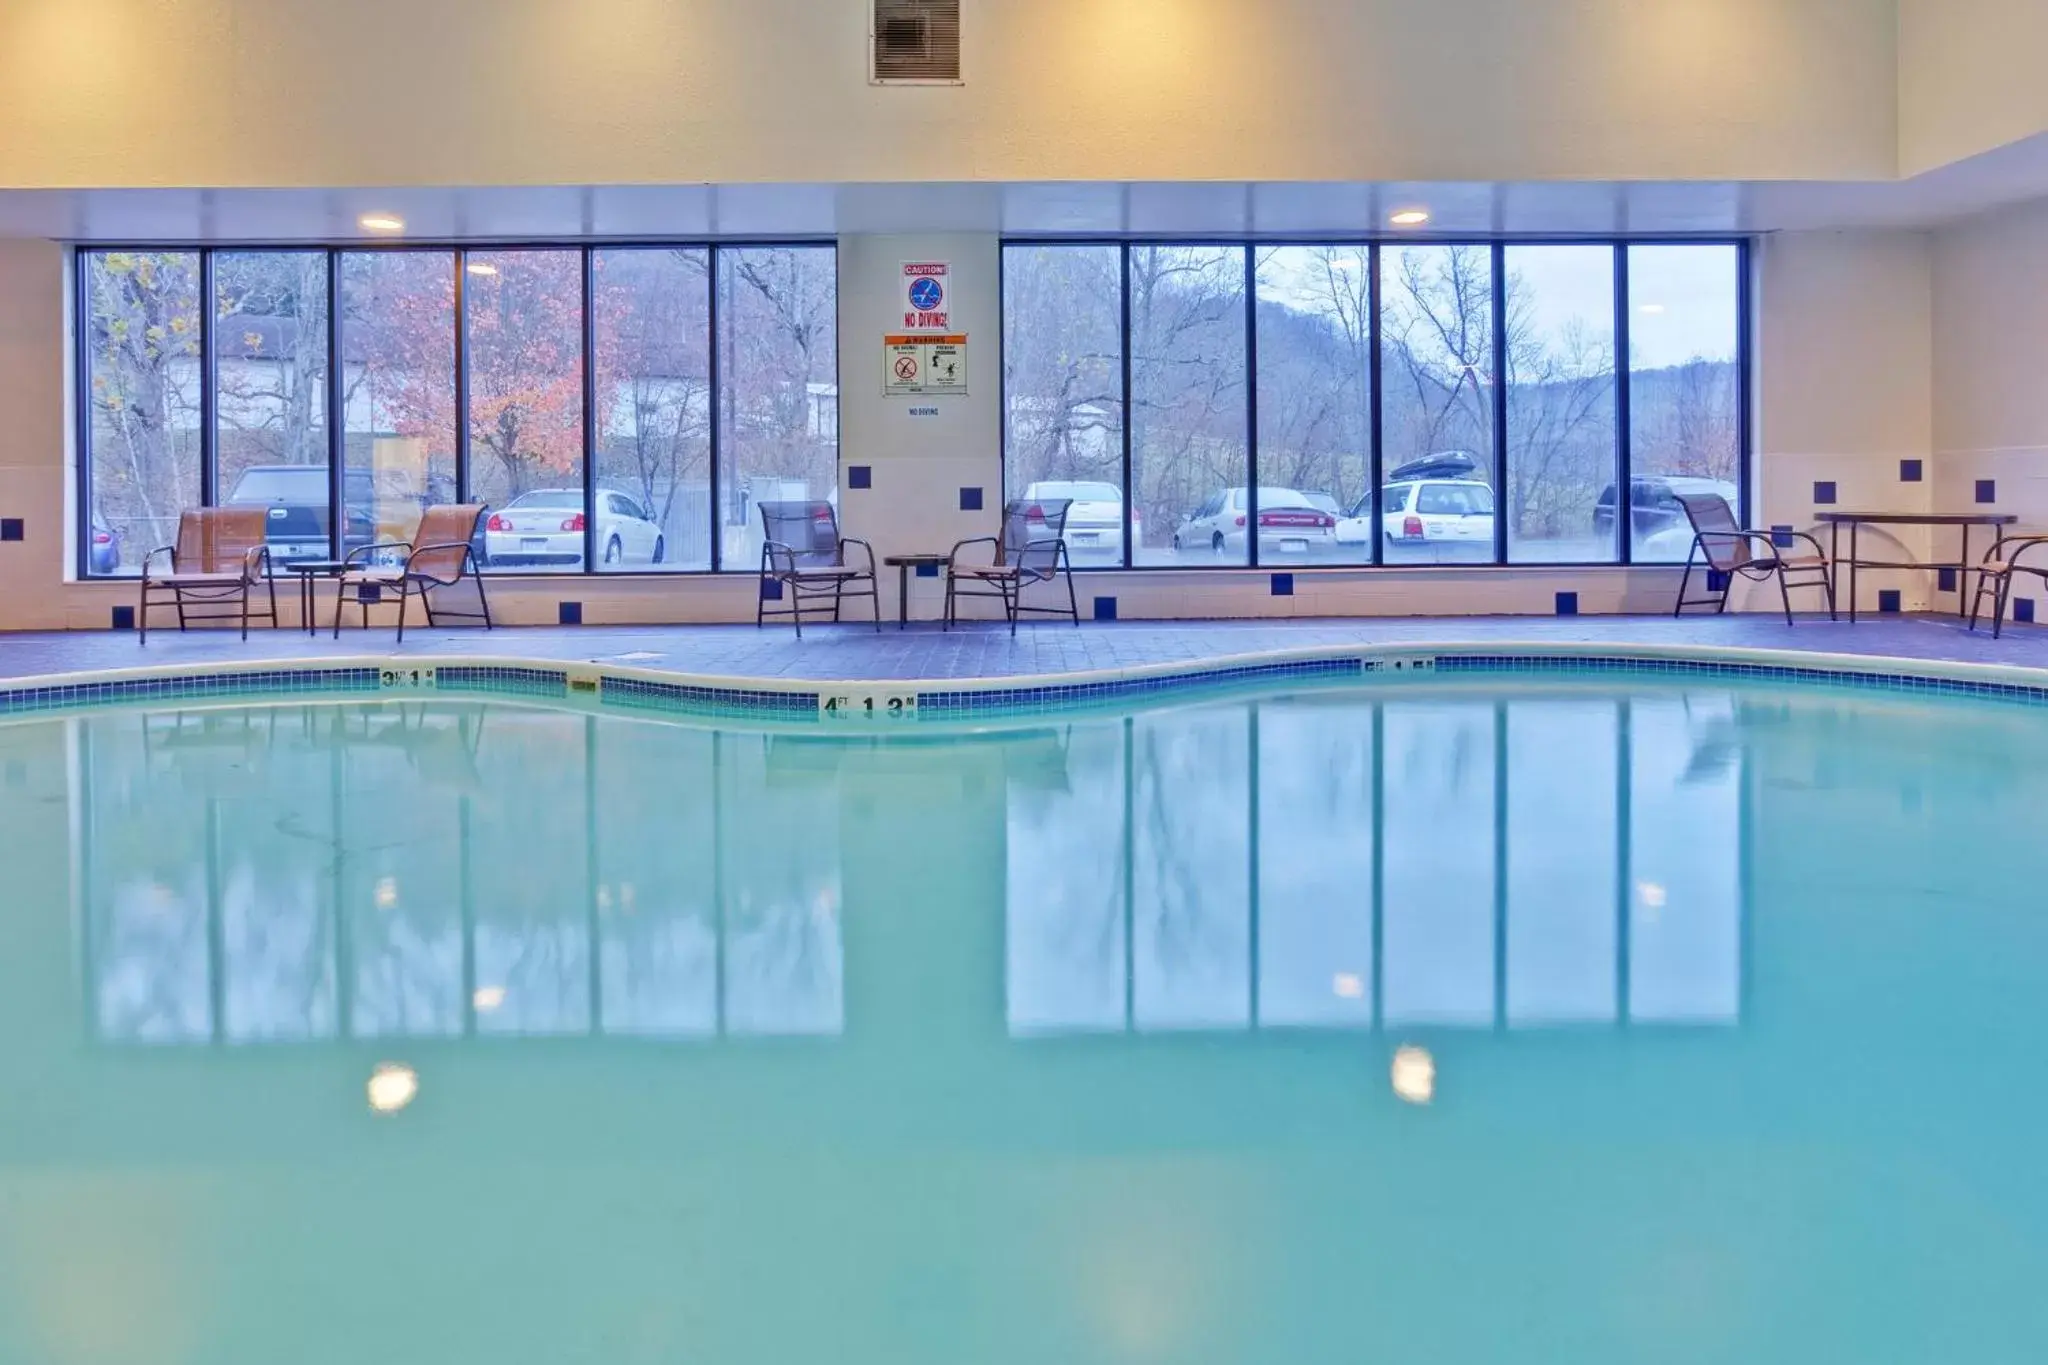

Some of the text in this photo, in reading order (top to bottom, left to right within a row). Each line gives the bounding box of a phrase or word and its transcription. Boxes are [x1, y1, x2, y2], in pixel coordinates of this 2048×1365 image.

[905, 312, 916, 328] NO
[909, 407, 939, 416] NO DIVING
